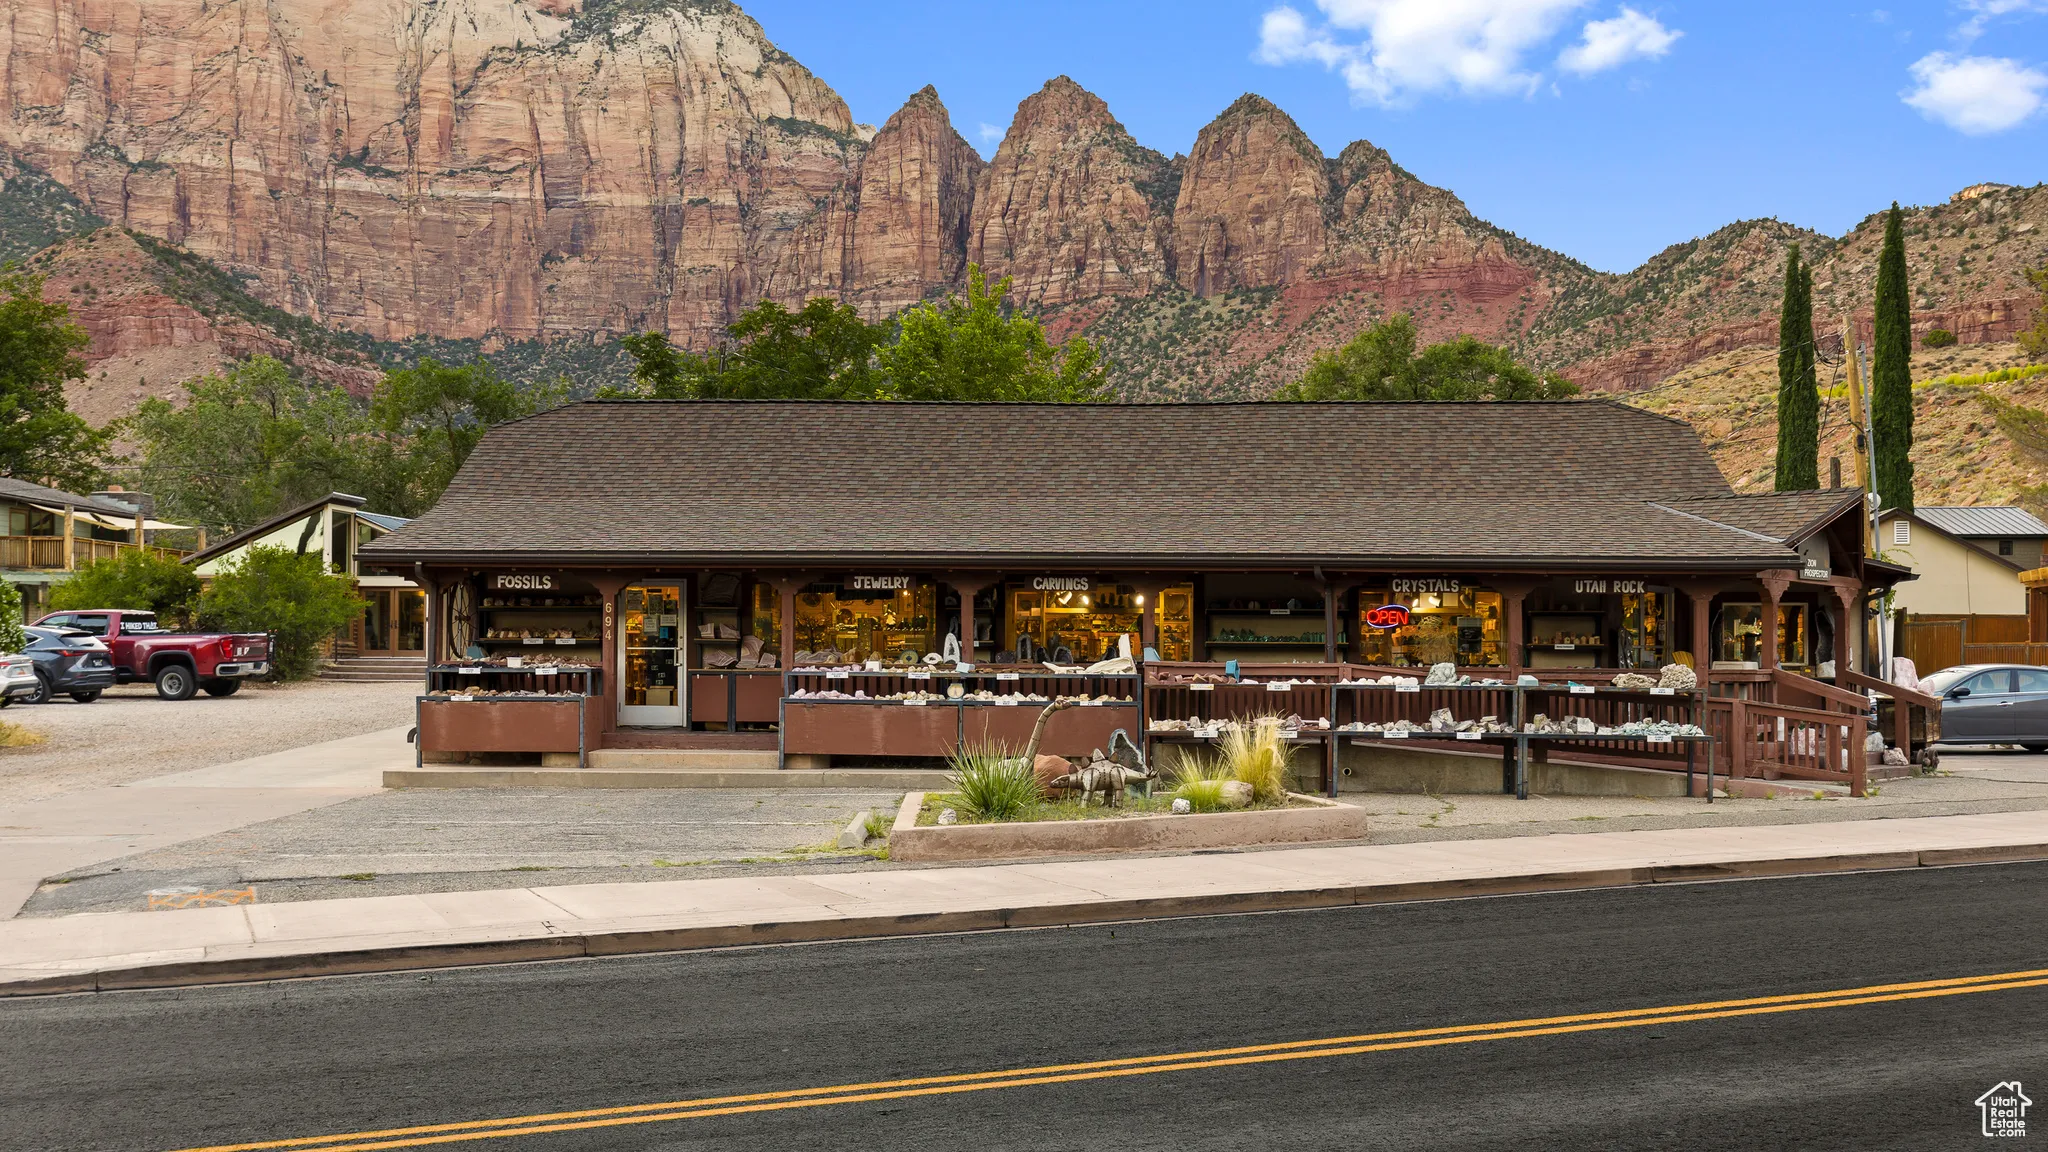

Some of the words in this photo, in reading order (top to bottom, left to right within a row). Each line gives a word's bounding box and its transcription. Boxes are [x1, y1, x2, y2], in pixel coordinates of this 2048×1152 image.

[1804, 568, 1829, 578] PROSPECTOR
[497, 575, 552, 589] FOSSILS
[853, 576, 910, 589] JEWELRY
[1033, 577, 1089, 591] CARVINGS
[1392, 579, 1460, 593] CRYSTALS
[1575, 580, 1607, 593] UTAH
[1613, 580, 1645, 594] ROCK
[1366, 609, 1409, 625] OPEN
[120, 621, 125, 630] I
[125, 621, 143, 630] HIKED
